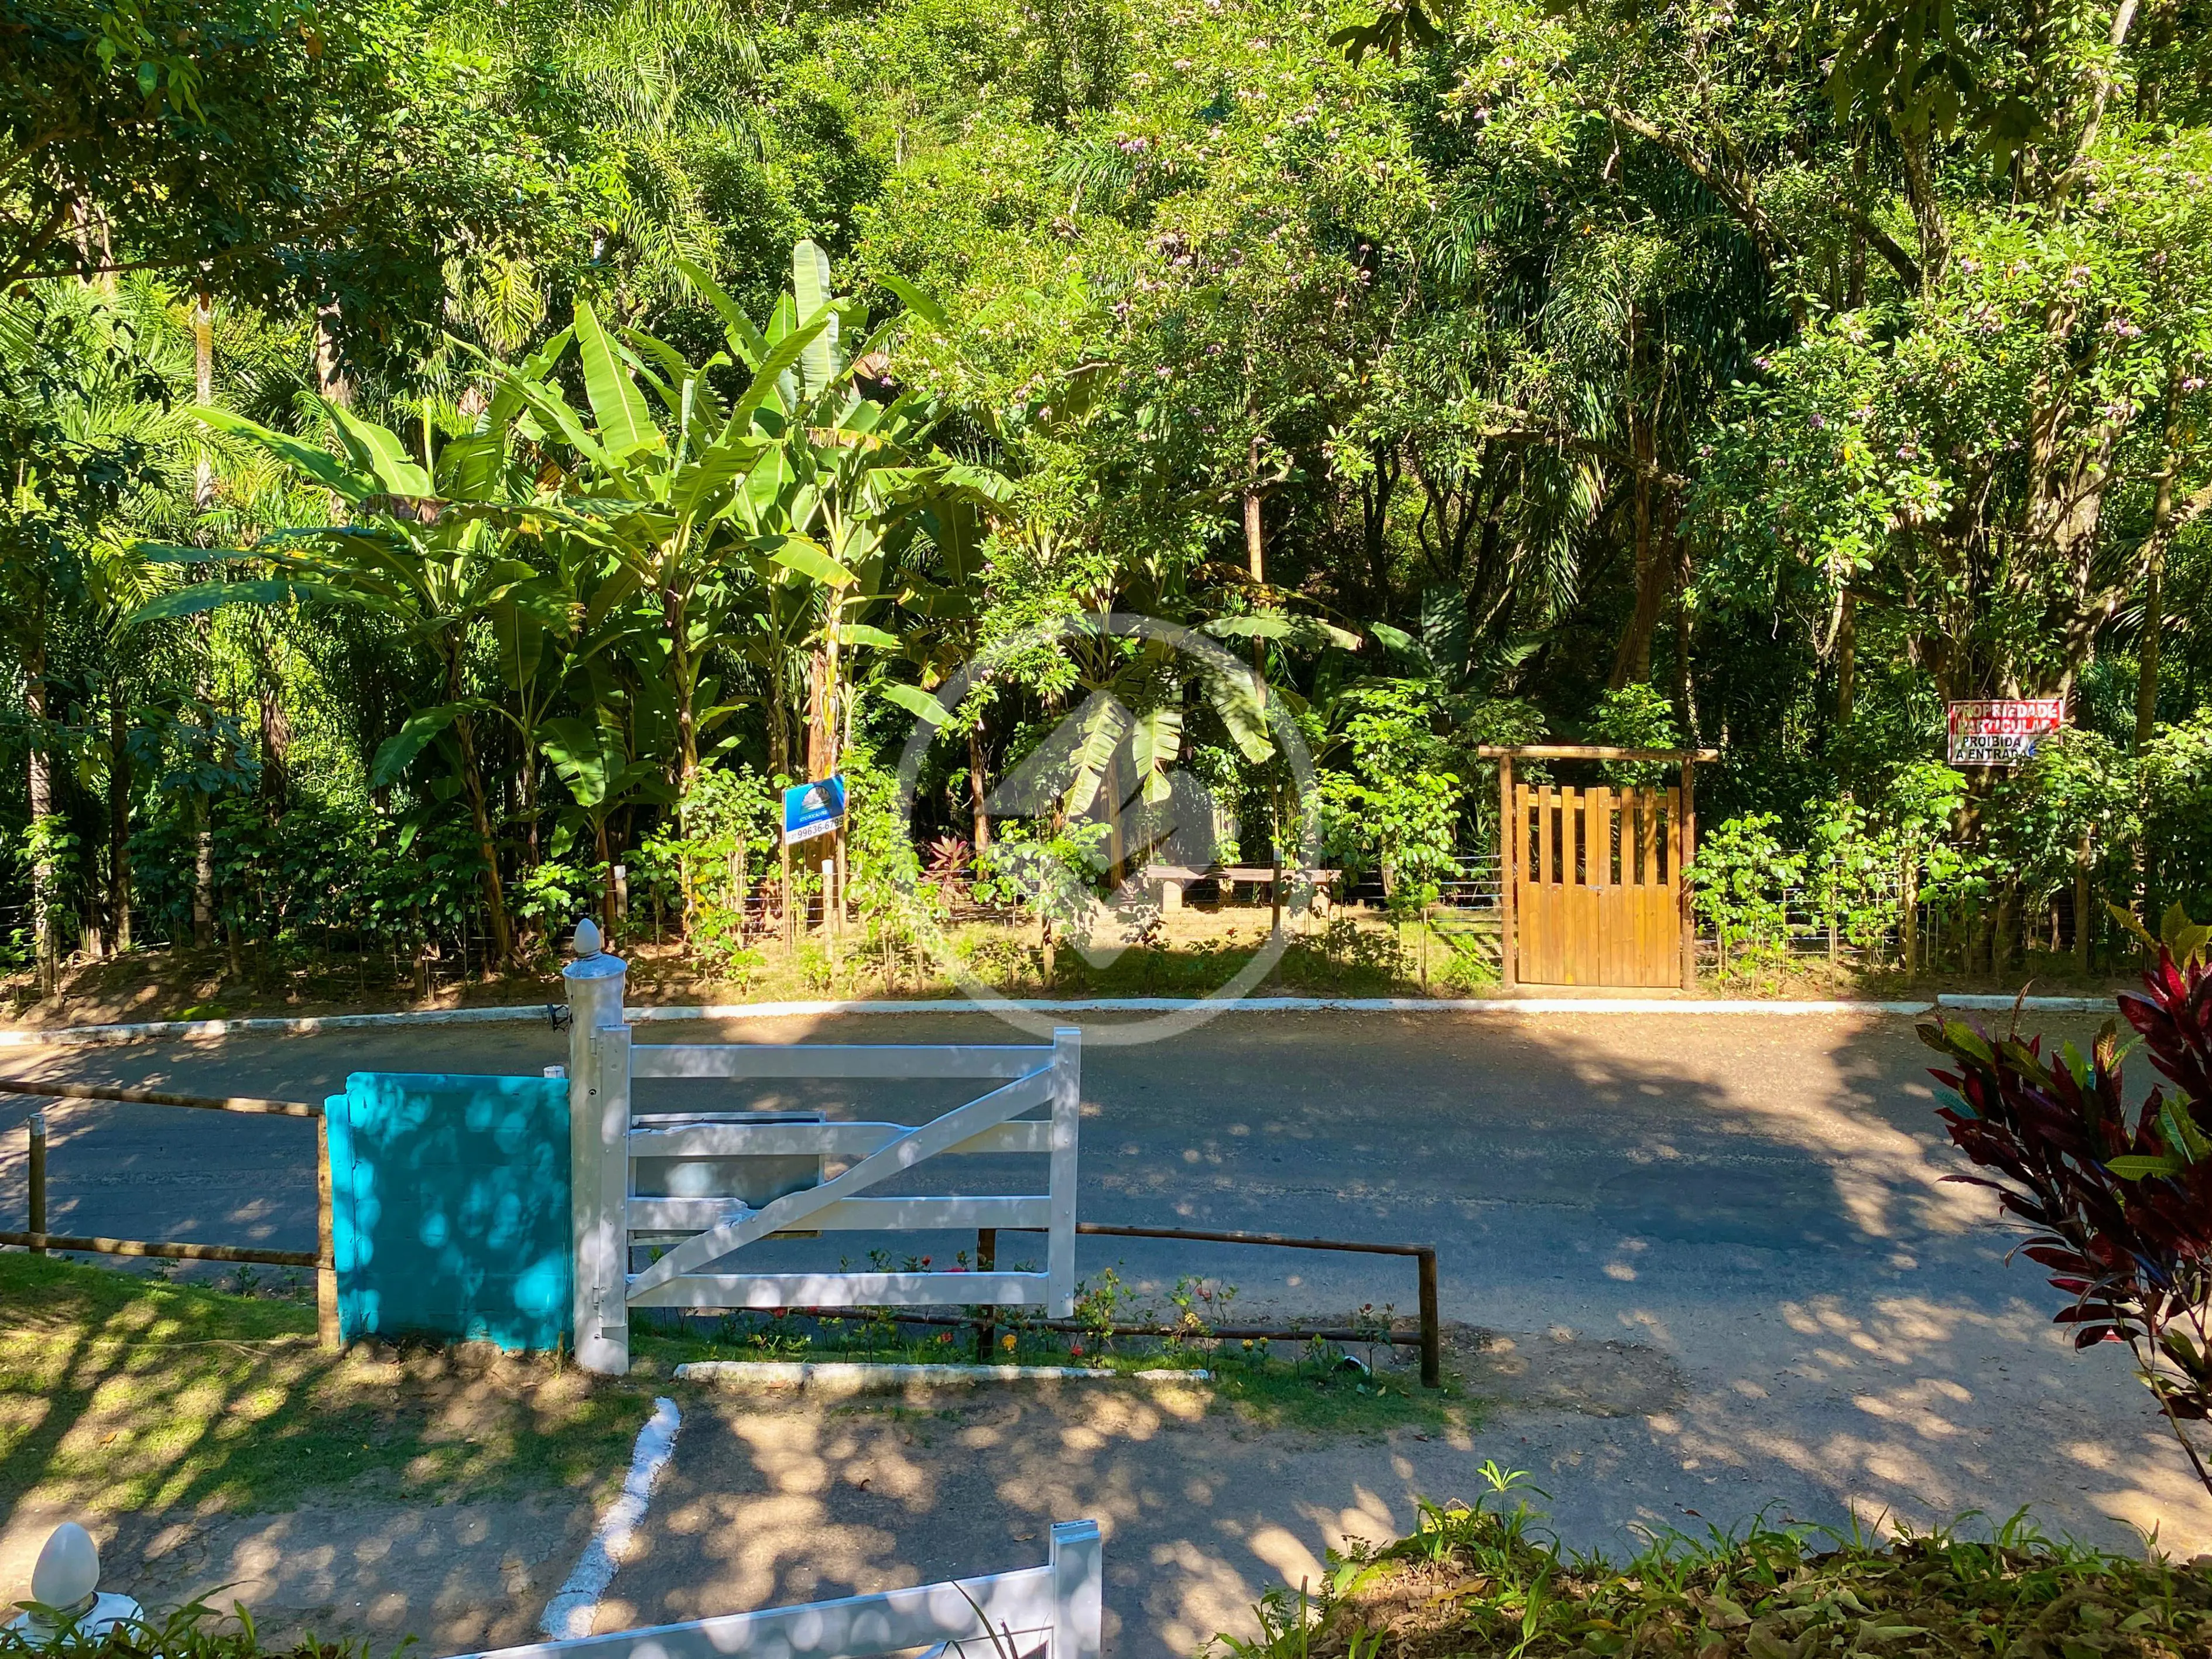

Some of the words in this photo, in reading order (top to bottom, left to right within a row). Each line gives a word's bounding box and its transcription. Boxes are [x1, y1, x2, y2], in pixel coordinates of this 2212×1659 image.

[1954, 704, 2057, 718] PROPRIEDADE
[1963, 736, 2021, 747] PROIBIDA
[1956, 750, 1963, 759] A
